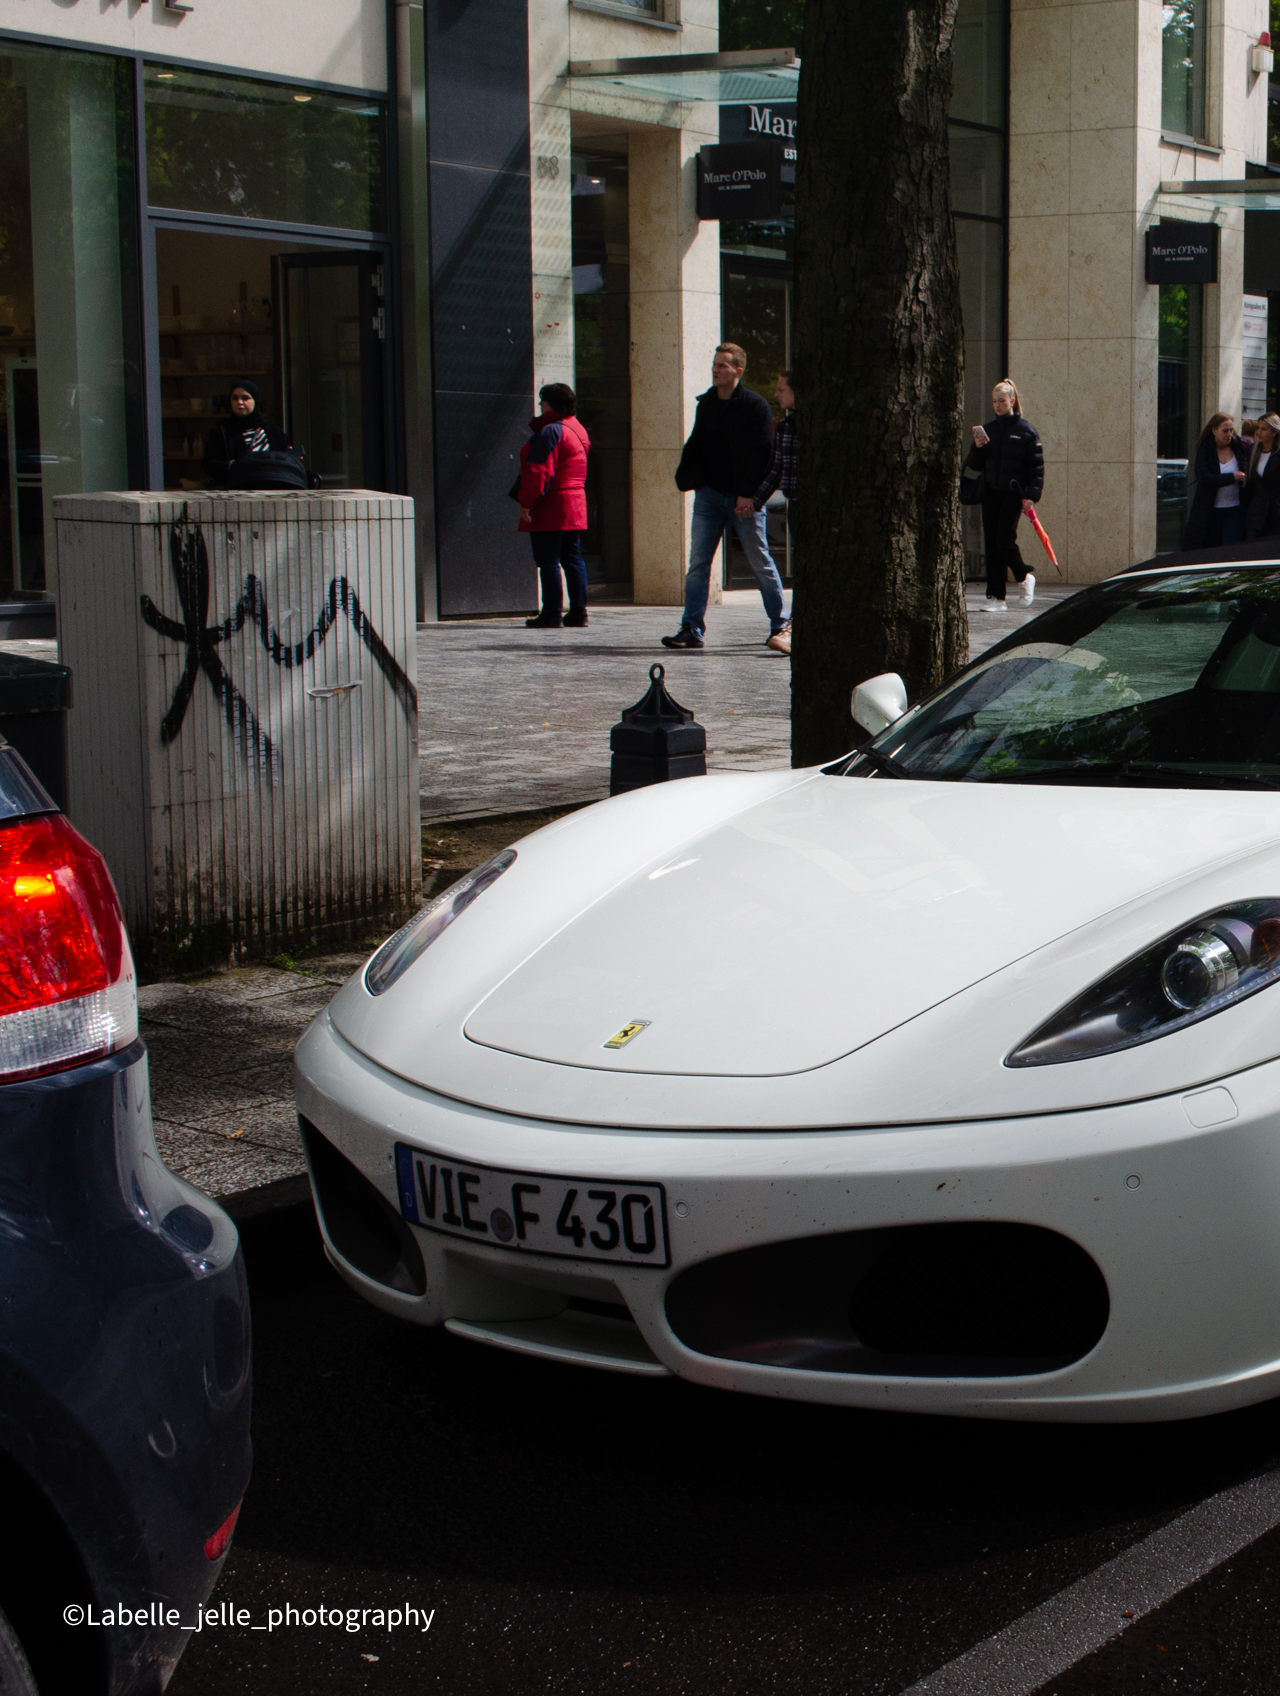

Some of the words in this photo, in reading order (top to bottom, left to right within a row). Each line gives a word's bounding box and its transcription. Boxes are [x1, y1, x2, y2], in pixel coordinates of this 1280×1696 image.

[703, 172, 731, 184] Marc
[732, 169, 767, 182] O'Polo
[1152, 246, 1177, 256] Marc
[1177, 245, 1208, 255] O'Polo
[406, 1192, 413, 1207] D
[415, 1159, 488, 1232] VIE
[511, 1182, 541, 1240] F
[556, 1188, 656, 1254] 430
